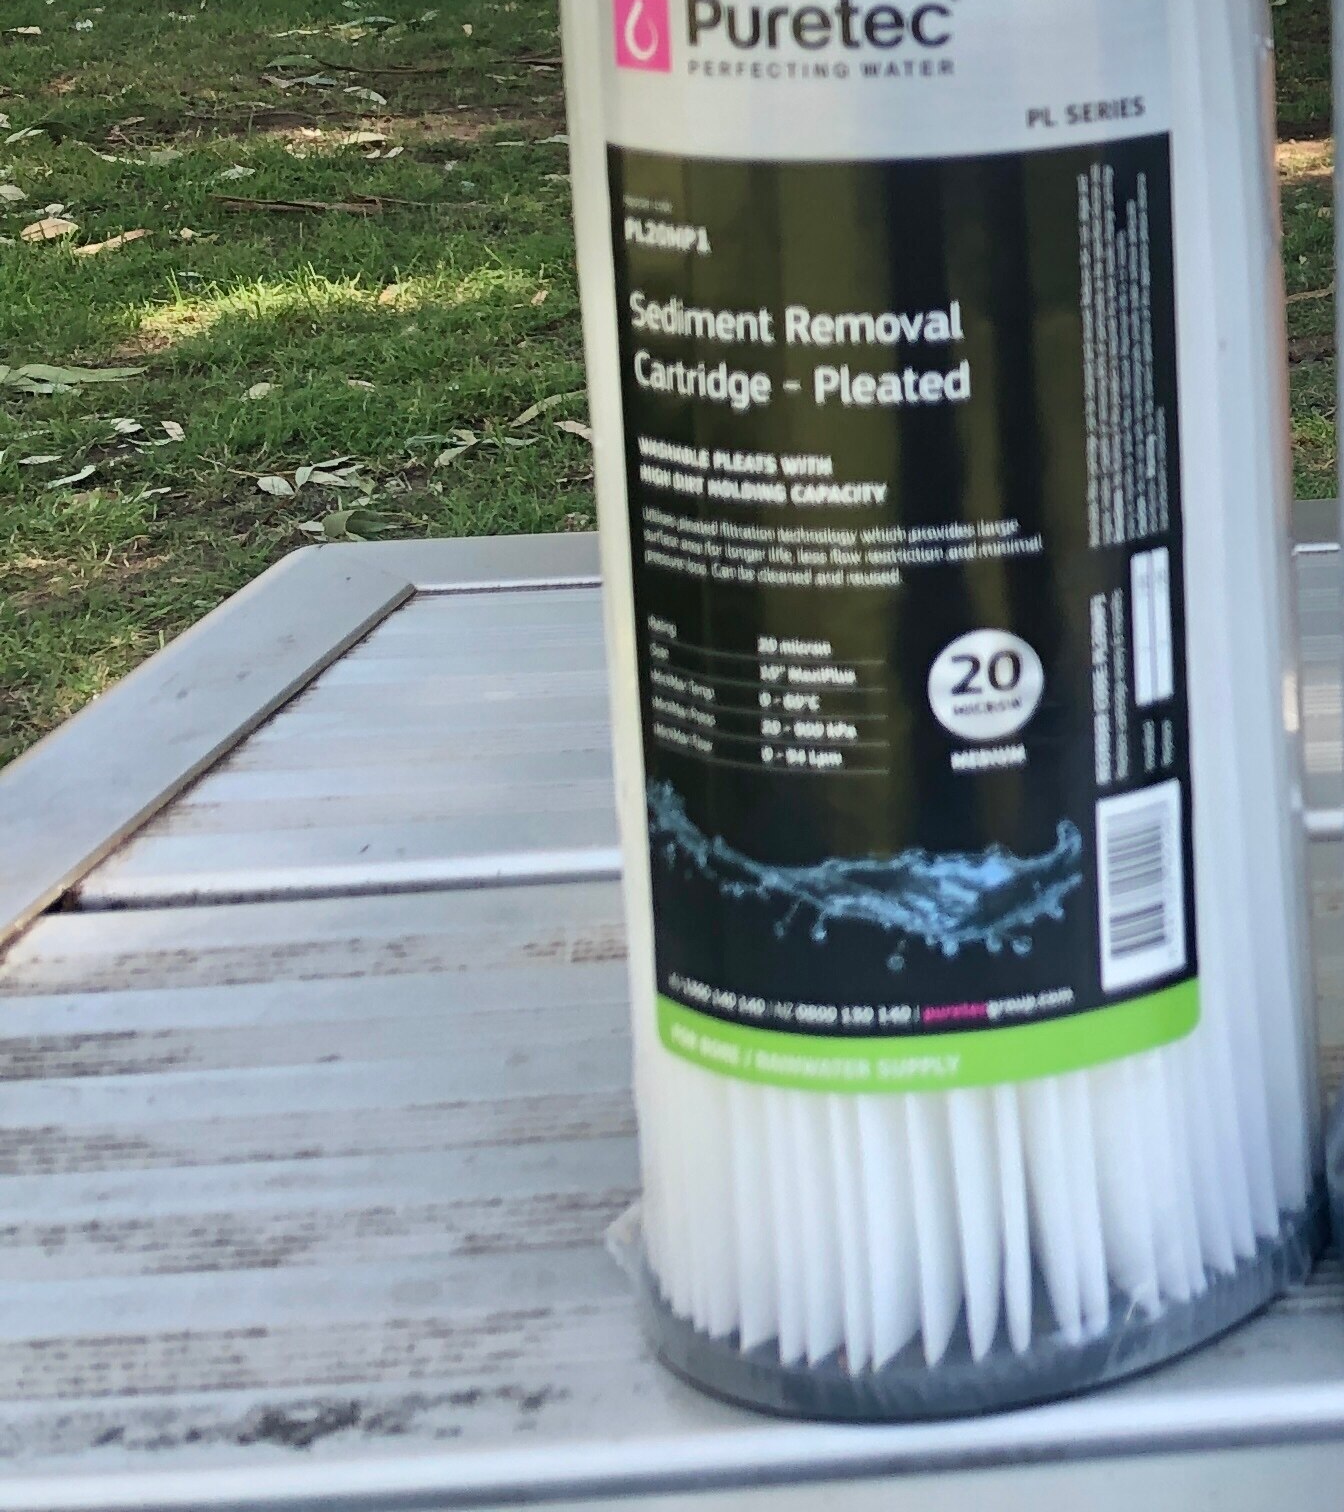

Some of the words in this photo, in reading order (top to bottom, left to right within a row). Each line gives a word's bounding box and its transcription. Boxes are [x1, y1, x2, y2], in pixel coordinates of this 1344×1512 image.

[686, 60, 851, 80] PERFECTING
[861, 58, 955, 78] WATER
[1026, 107, 1058, 129] PL
[1065, 95, 1147, 126] SERIES
[629, 290, 776, 344] Sediment
[784, 300, 965, 346] Removal
[633, 348, 772, 410] Cartridge
[813, 358, 972, 406] Pleated
[712, 449, 778, 476] PLEATS
[779, 453, 833, 477] WITH
[639, 463, 672, 489] HIGH
[790, 480, 889, 507] CAPACITY
[908, 521, 976, 544] provides
[780, 637, 833, 659] micron
[950, 649, 1024, 697] 20
[875, 1052, 963, 1081] SUPPLY
